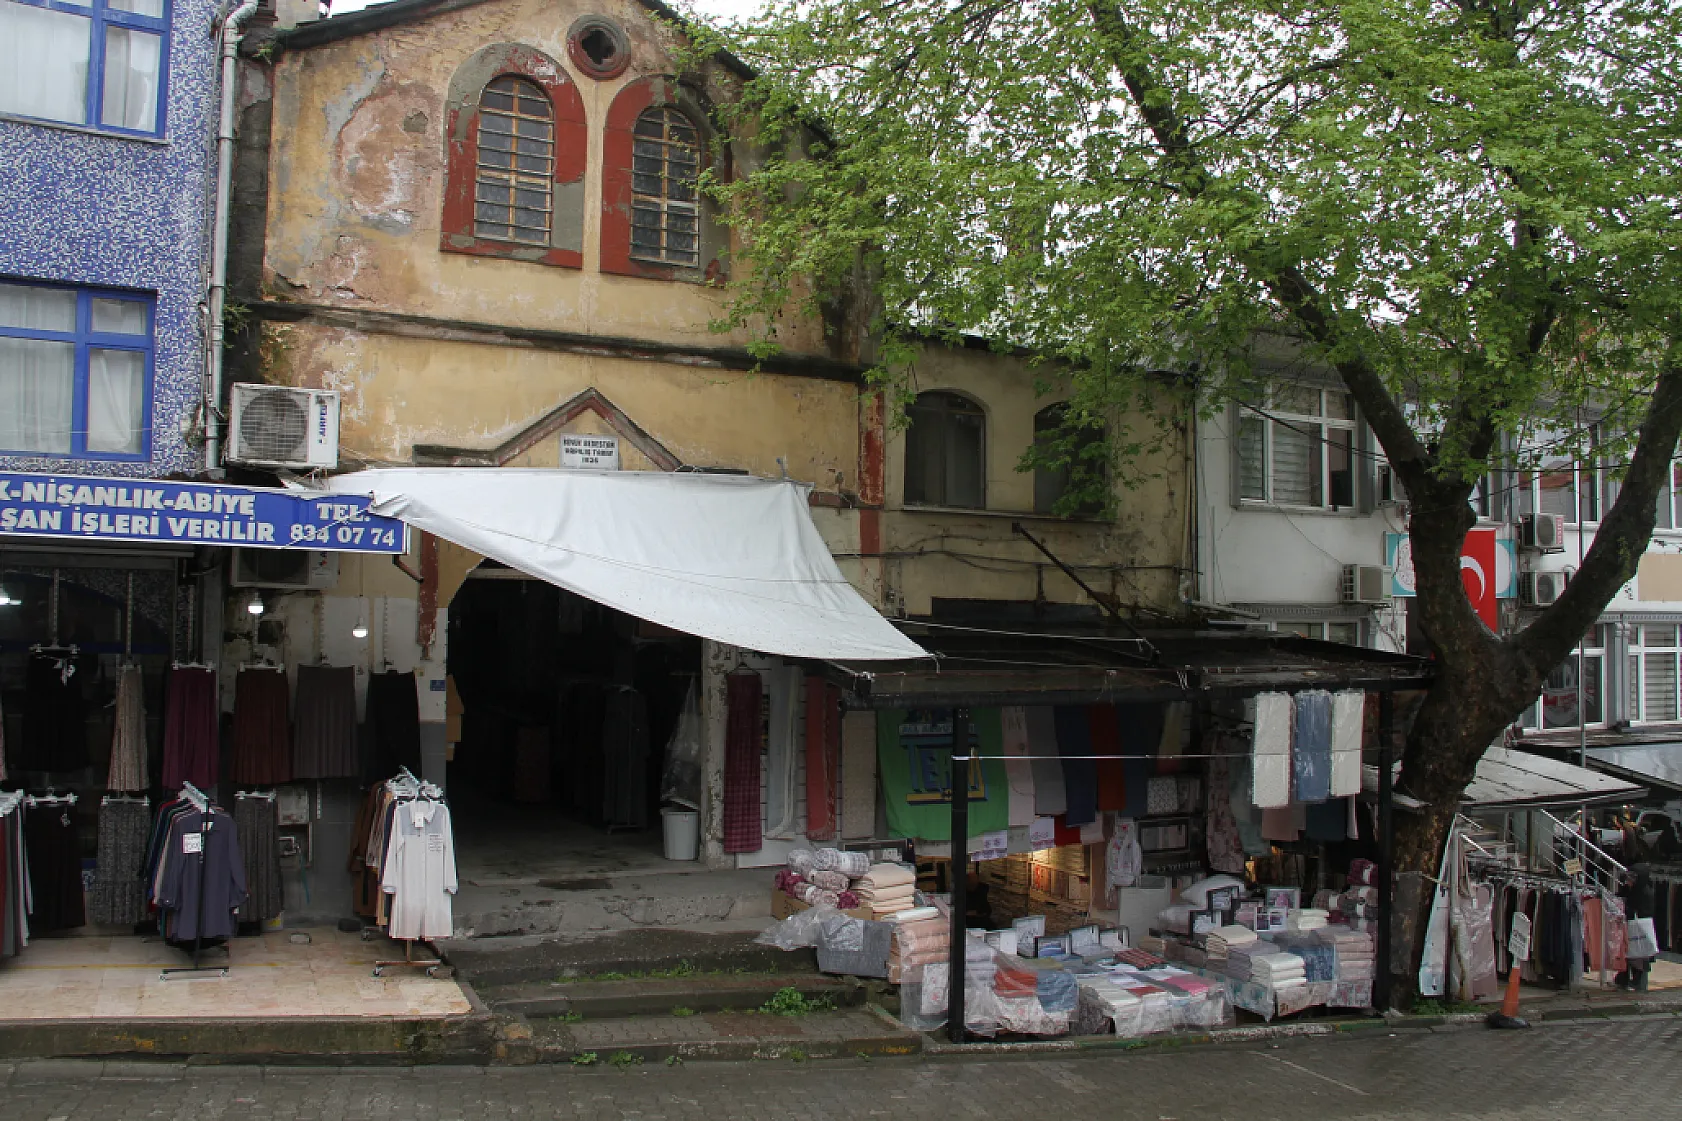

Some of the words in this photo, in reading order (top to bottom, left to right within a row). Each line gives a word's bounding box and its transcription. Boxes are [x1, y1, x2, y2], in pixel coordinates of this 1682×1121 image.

[72, 506, 159, 536] İŞLERİ
[166, 514, 275, 541] VERİLİR
[317, 503, 371, 522] TEL.
[291, 523, 330, 543] 834
[337, 526, 365, 545] 07
[371, 527, 395, 547] 74
